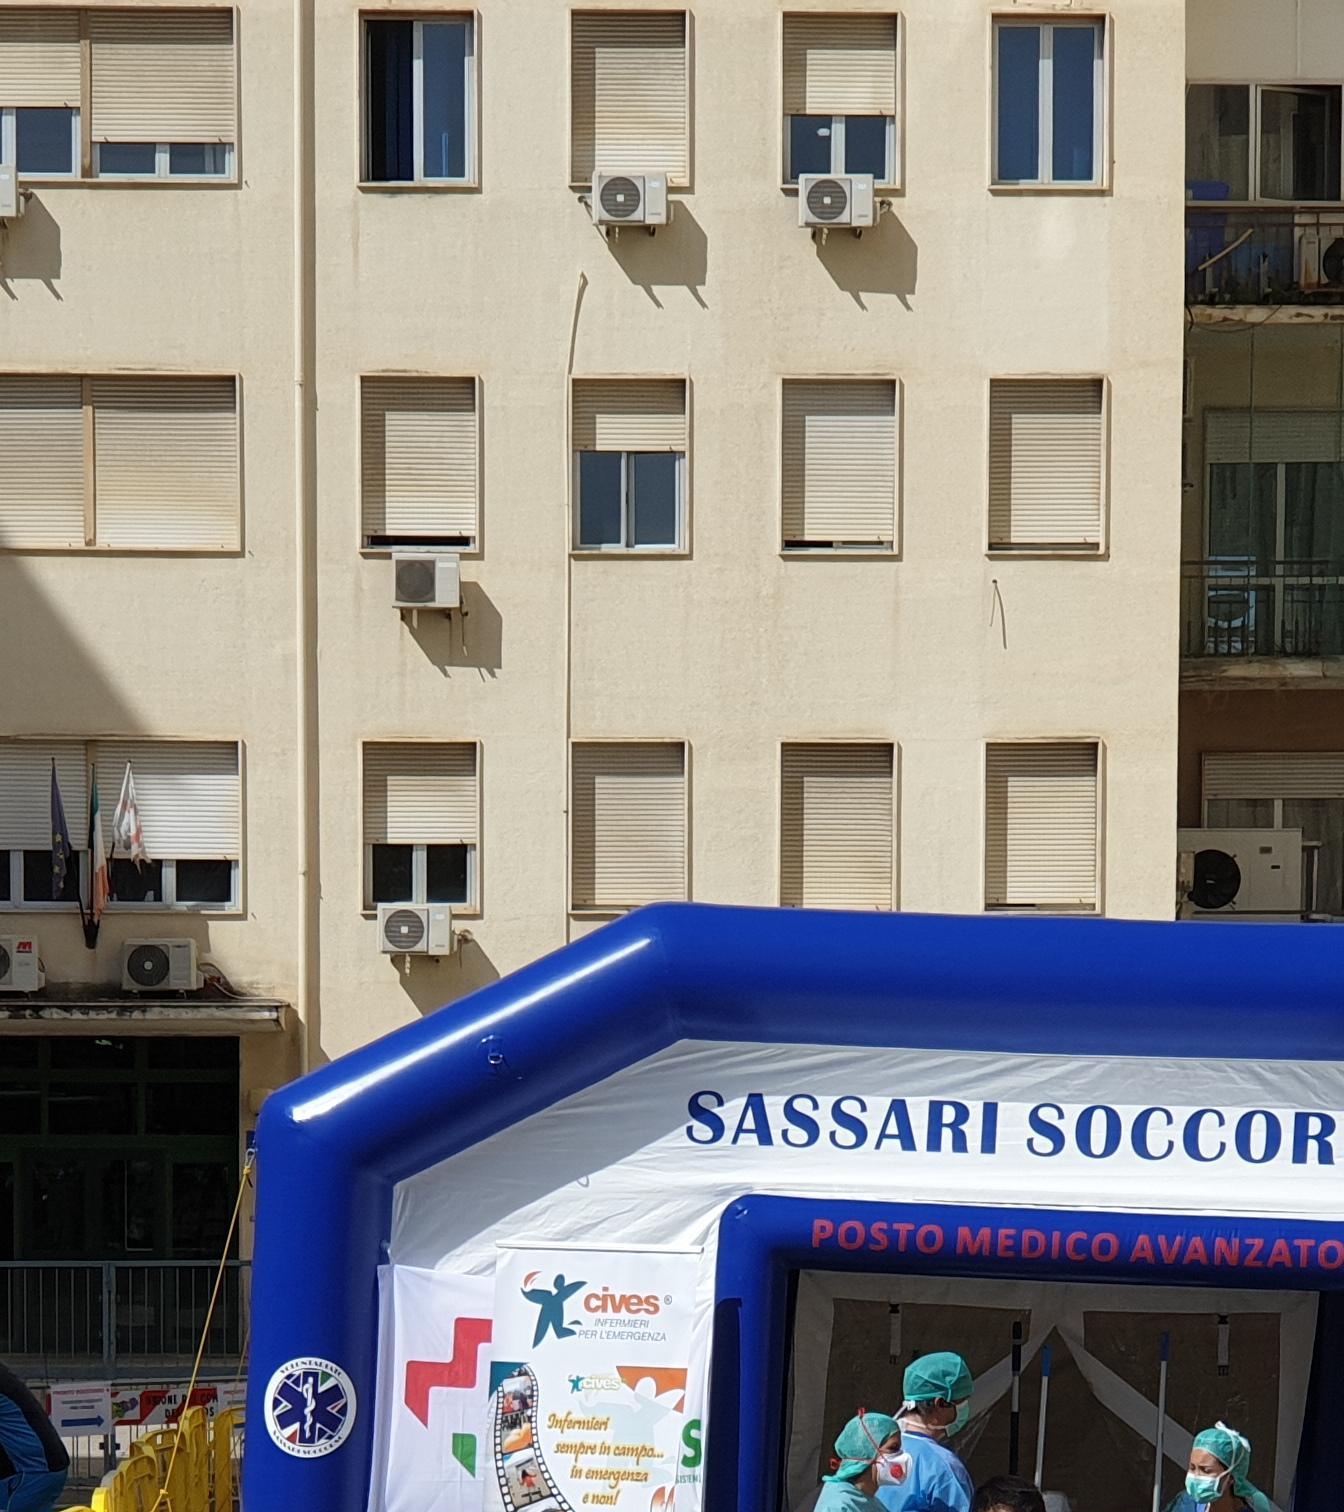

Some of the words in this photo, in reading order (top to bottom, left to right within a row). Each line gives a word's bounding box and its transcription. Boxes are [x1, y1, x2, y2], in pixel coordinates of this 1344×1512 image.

[685, 1089, 998, 1156] SASSARI
[811, 1218, 941, 1256] POSTO
[955, 1226, 1120, 1264] MEDICO
[583, 1286, 660, 1316] cives
[594, 1317, 650, 1330] INFERMIERI
[578, 1329, 597, 1341] PER
[599, 1330, 668, 1343] L'EMERGENZA
[581, 1373, 621, 1392] cives
[547, 1412, 610, 1432] Infermieri
[554, 1443, 598, 1462] sempre
[599, 1441, 611, 1457] in
[570, 1465, 583, 1480] in
[586, 1468, 649, 1488] emergenza
[591, 1490, 621, 1507] non!
